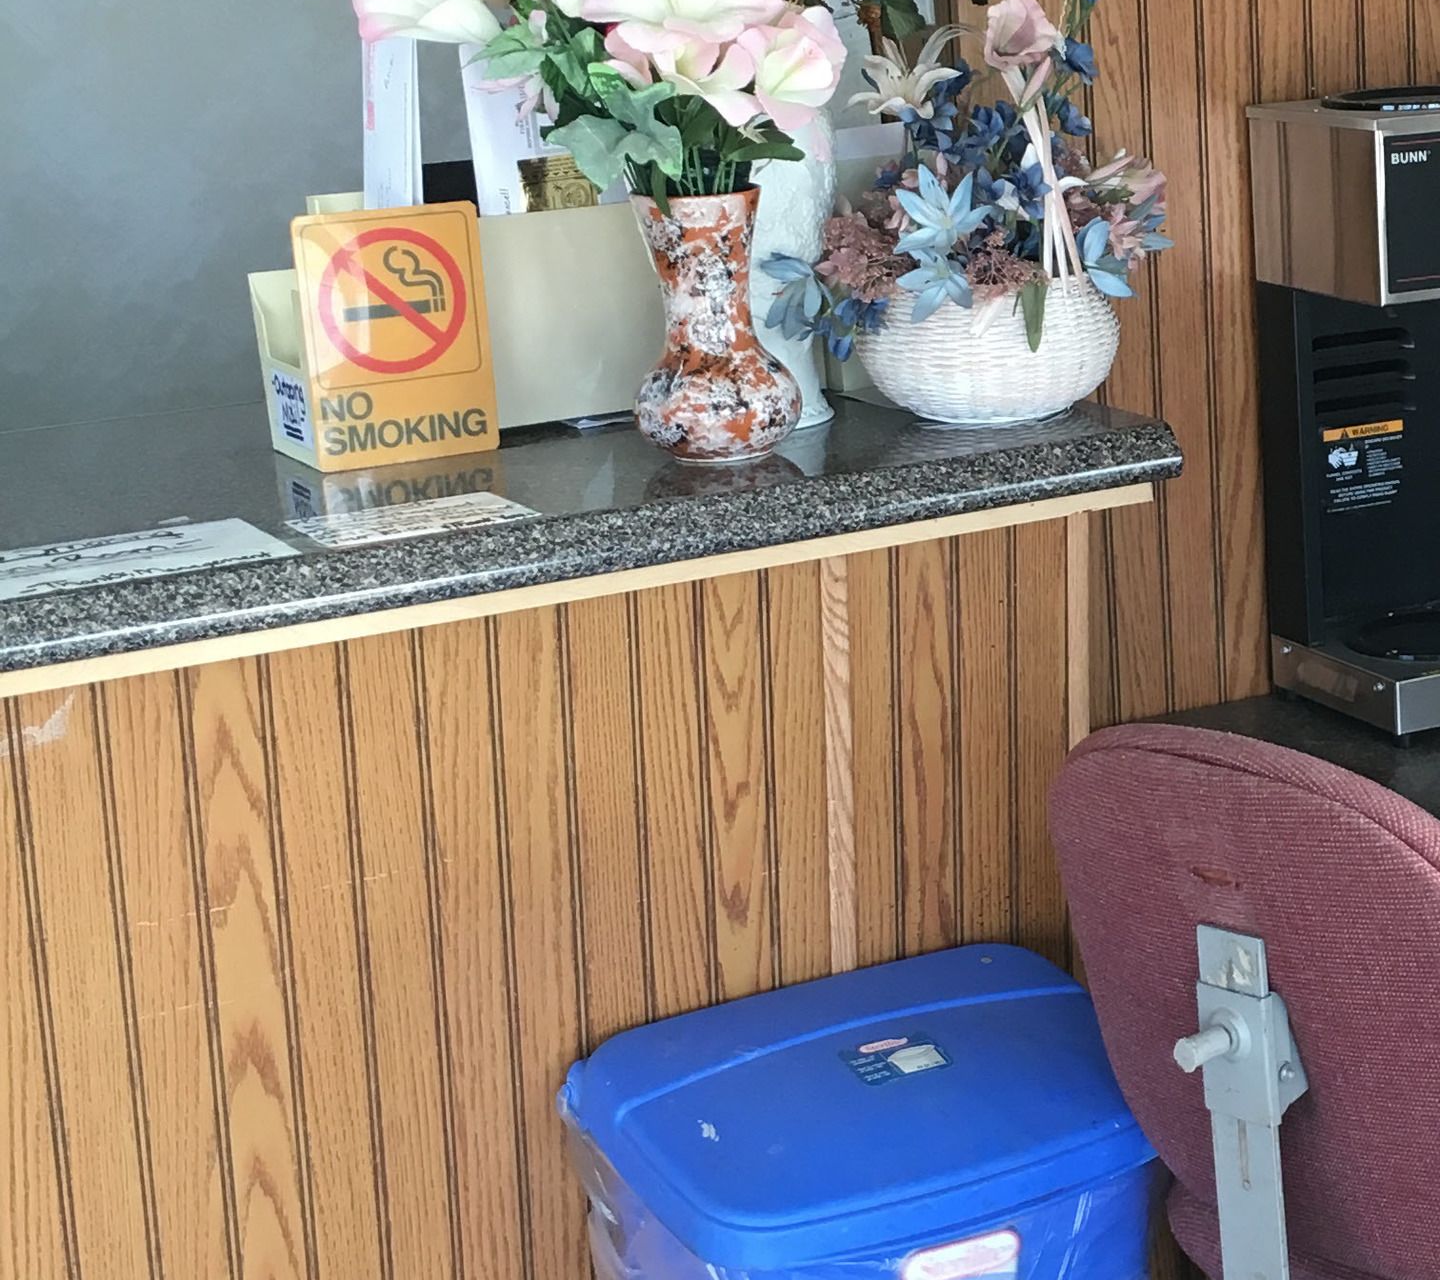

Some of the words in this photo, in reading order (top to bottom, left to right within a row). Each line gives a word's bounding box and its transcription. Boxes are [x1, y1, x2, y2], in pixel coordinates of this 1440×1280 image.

[1390, 151, 1428, 165] BUNN
[319, 391, 373, 423] NO
[324, 408, 488, 457] SMOKING
[1352, 424, 1389, 436] WARNING
